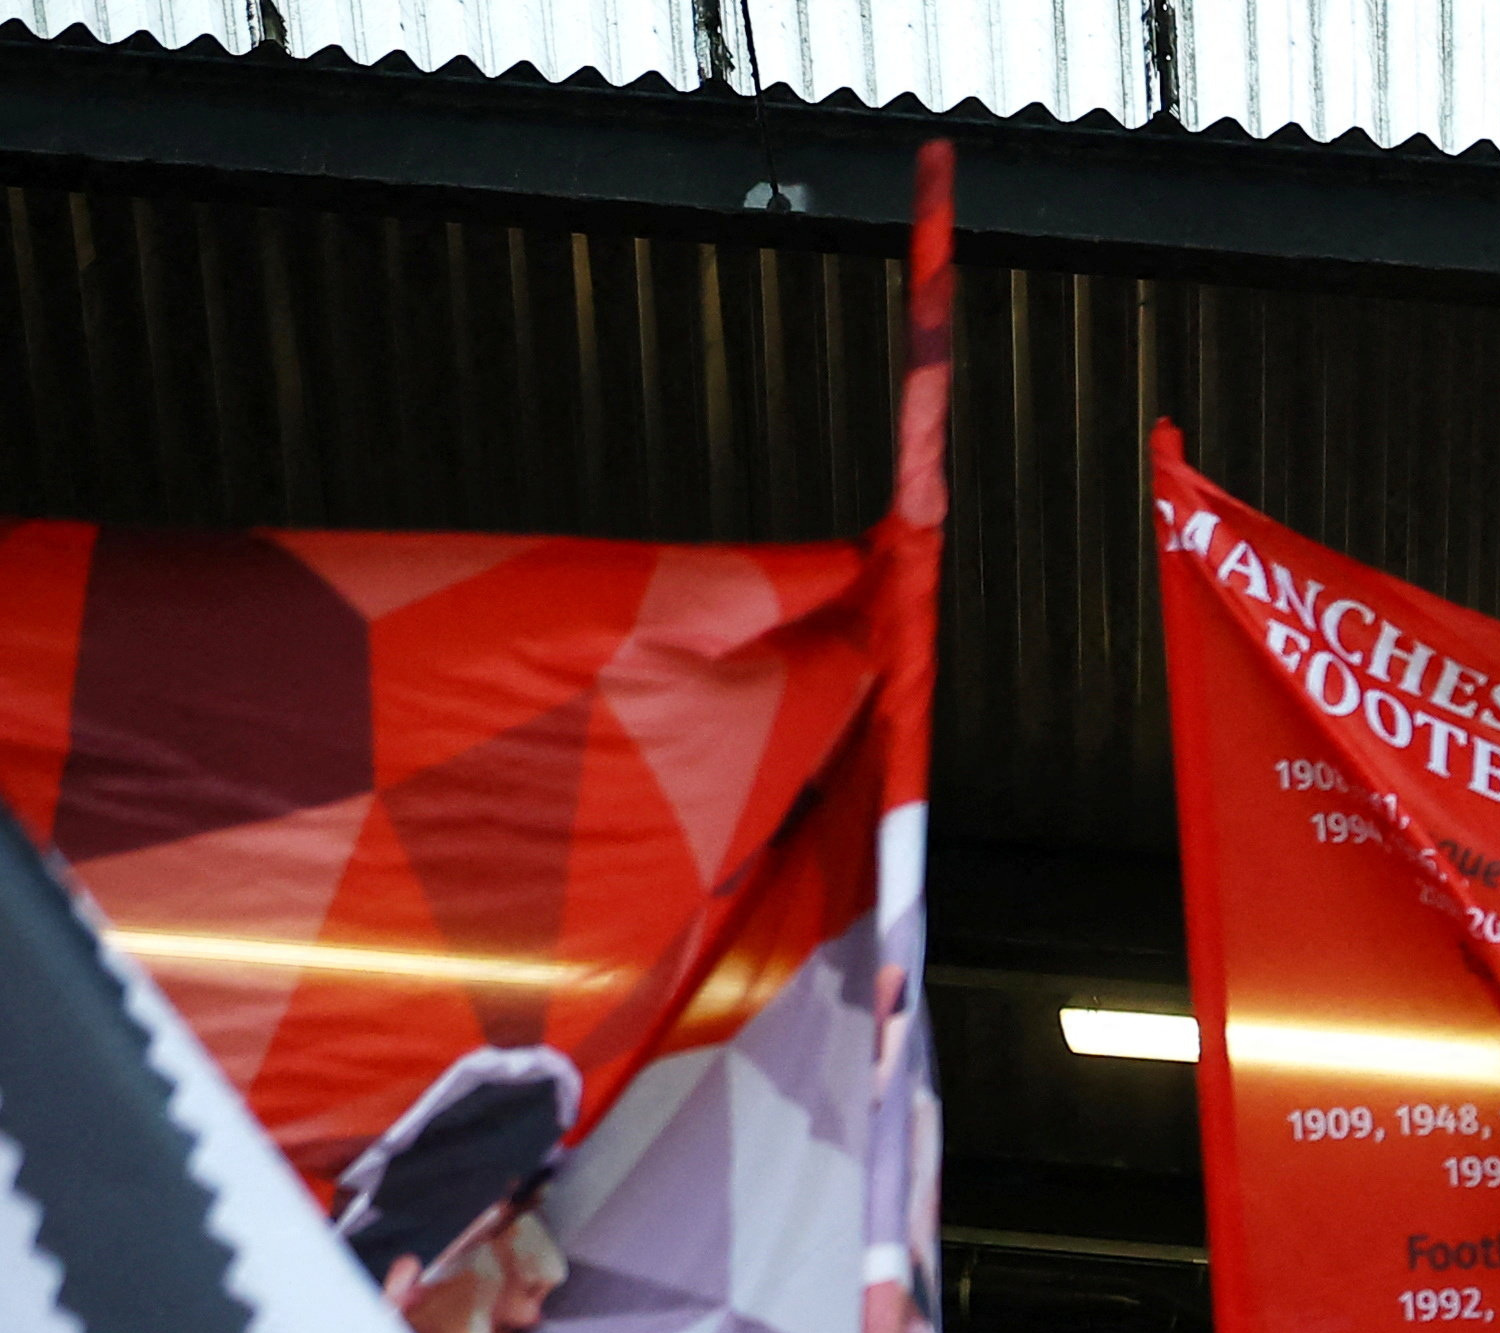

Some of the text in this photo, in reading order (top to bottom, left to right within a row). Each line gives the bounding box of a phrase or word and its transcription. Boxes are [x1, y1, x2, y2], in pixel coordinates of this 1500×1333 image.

[1287, 1105, 1387, 1143] 1909,
[1395, 1103, 1493, 1141] 1948,
[1399, 1286, 1495, 1323] 1992,
